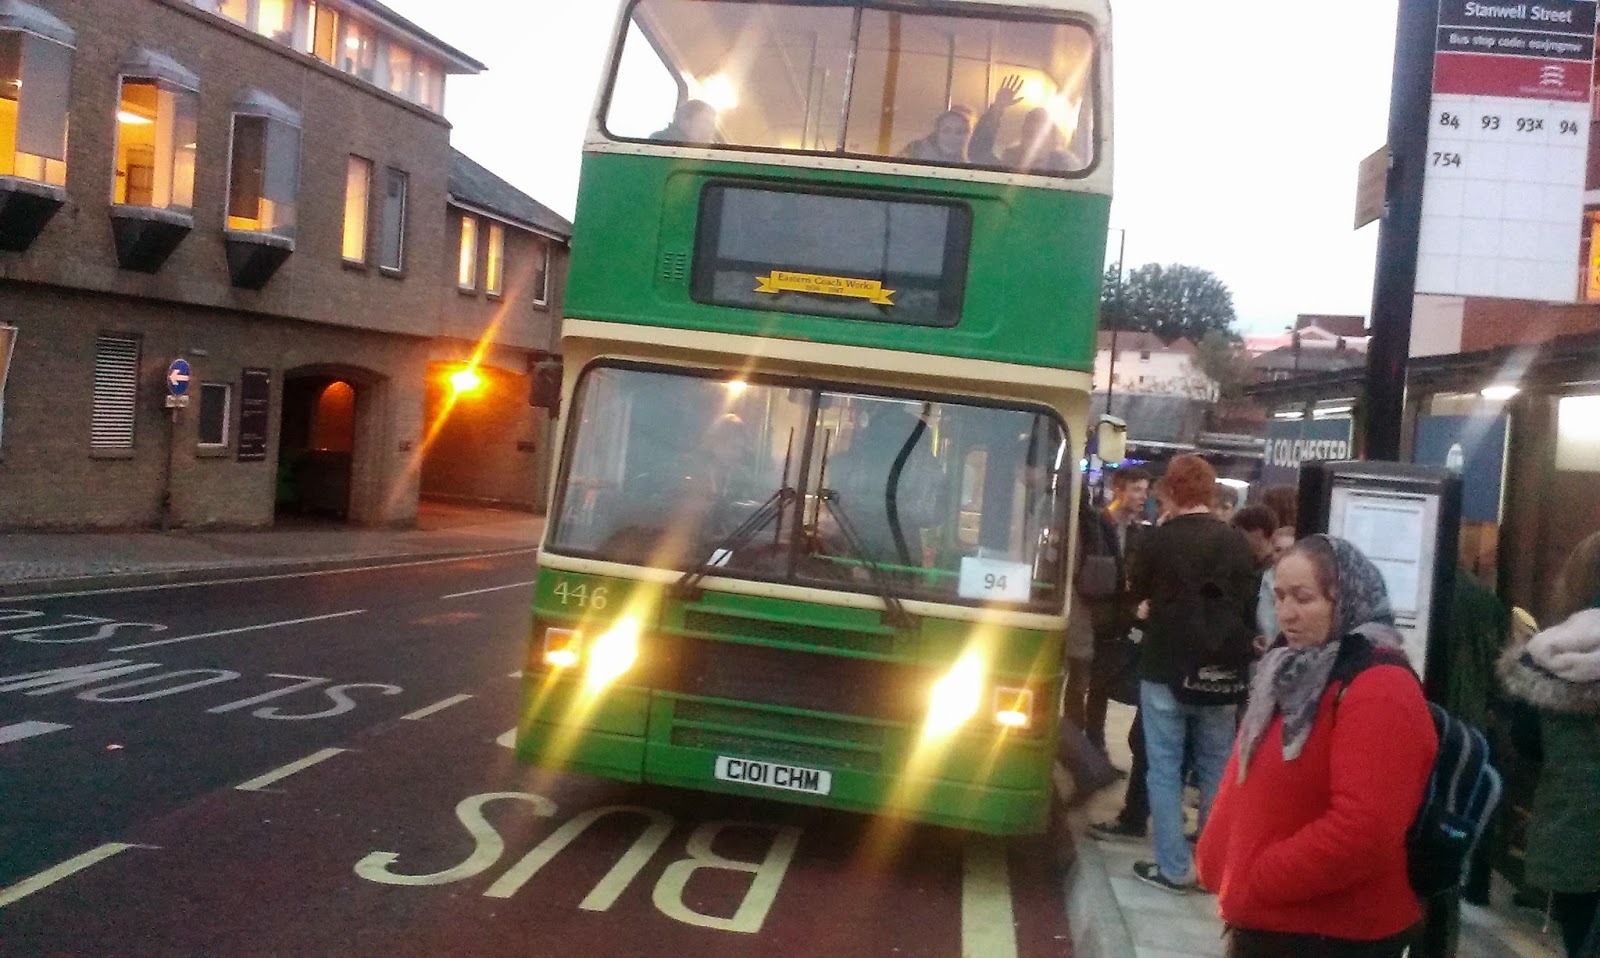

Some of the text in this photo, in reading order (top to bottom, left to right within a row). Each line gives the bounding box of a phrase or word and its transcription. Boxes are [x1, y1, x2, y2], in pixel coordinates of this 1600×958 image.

[1464, 2, 1573, 24] Stanwell Street
[1440, 112, 1460, 130] 84
[1481, 115, 1500, 130] 93
[1560, 120, 1578, 136] 94
[1432, 151, 1462, 168] 754
[777, 272, 874, 290] Eastern Coach Works
[984, 572, 1008, 591] 94
[553, 581, 609, 610] 446
[726, 759, 820, 791] C101 CHM
[353, 791, 806, 934] BUS
